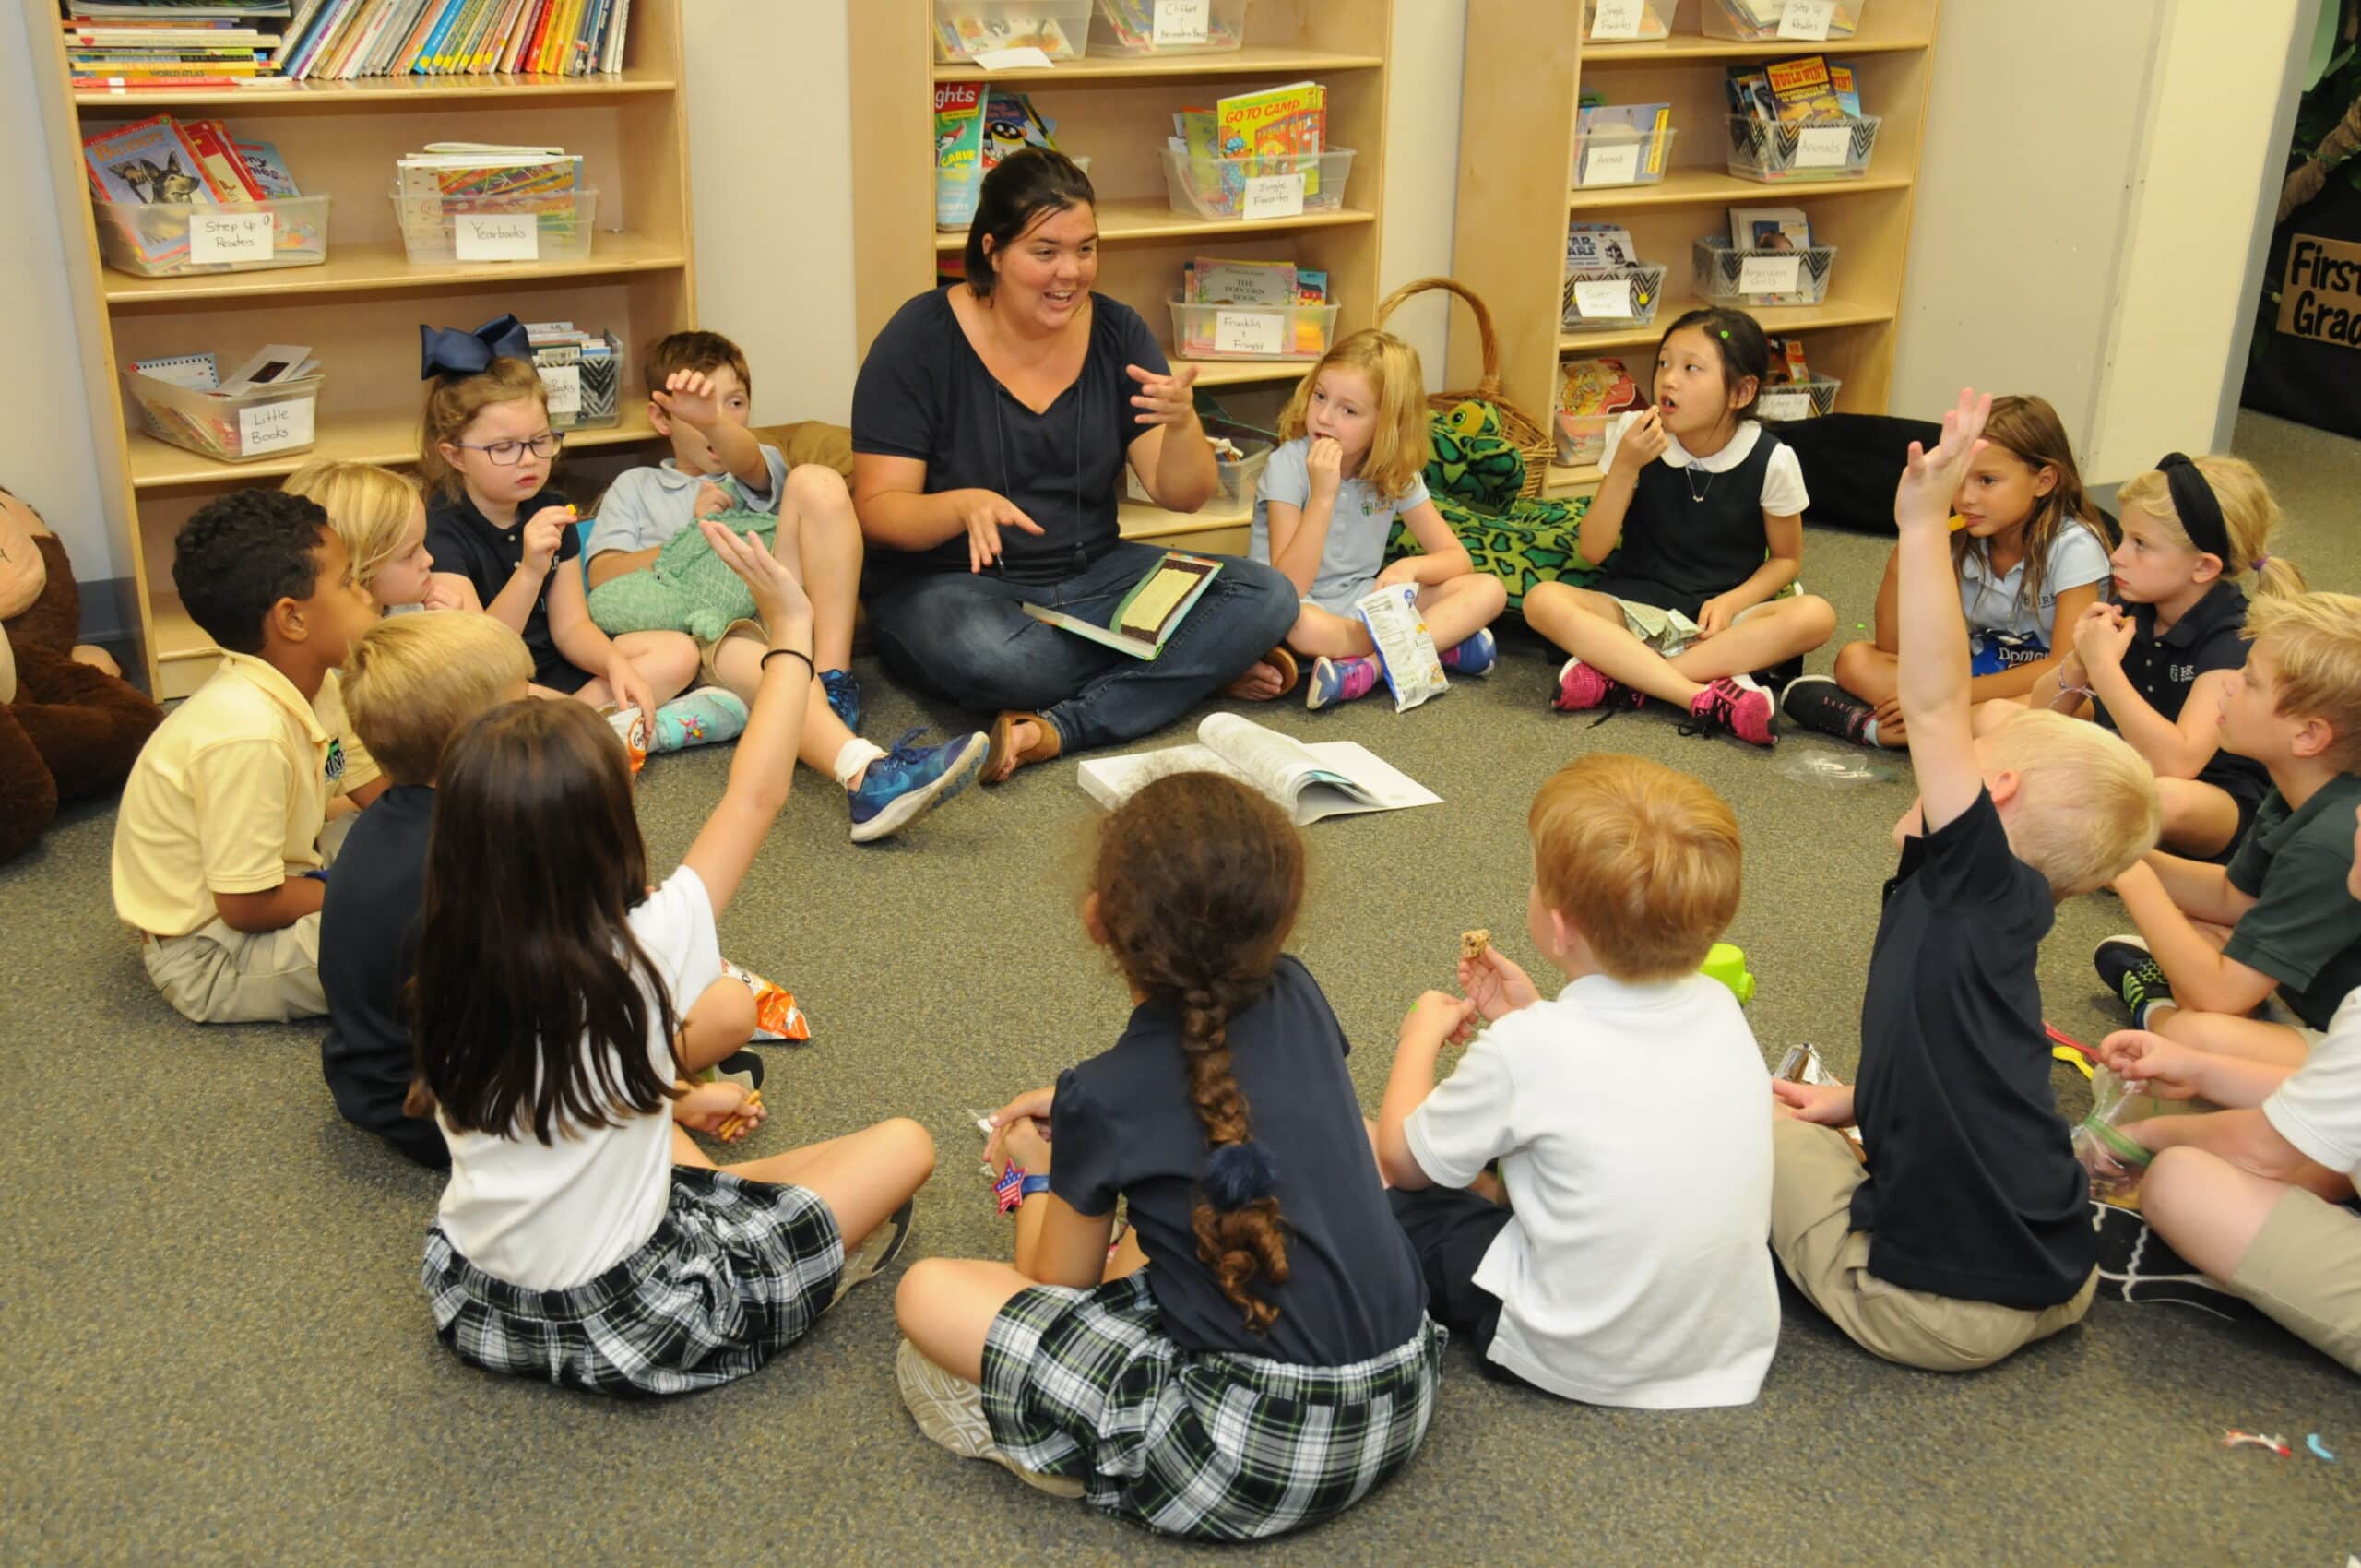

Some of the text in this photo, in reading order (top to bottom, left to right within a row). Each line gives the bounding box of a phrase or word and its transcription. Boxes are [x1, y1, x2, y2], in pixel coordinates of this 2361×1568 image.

[1772, 71, 1803, 90] WOULD
[935, 84, 975, 109] ghts
[1225, 110, 1244, 124] GO
[1247, 106, 1262, 120] TO
[1264, 99, 1300, 117] CAMP
[241, 155, 267, 167] ony
[941, 150, 976, 166] CARVE
[206, 220, 238, 233] Step
[470, 220, 527, 241] Yearbooks
[214, 233, 255, 248] Readers
[1569, 236, 1595, 246] AR
[1567, 246, 1596, 256] ARS
[254, 407, 289, 426] Little
[251, 425, 289, 444] Books
